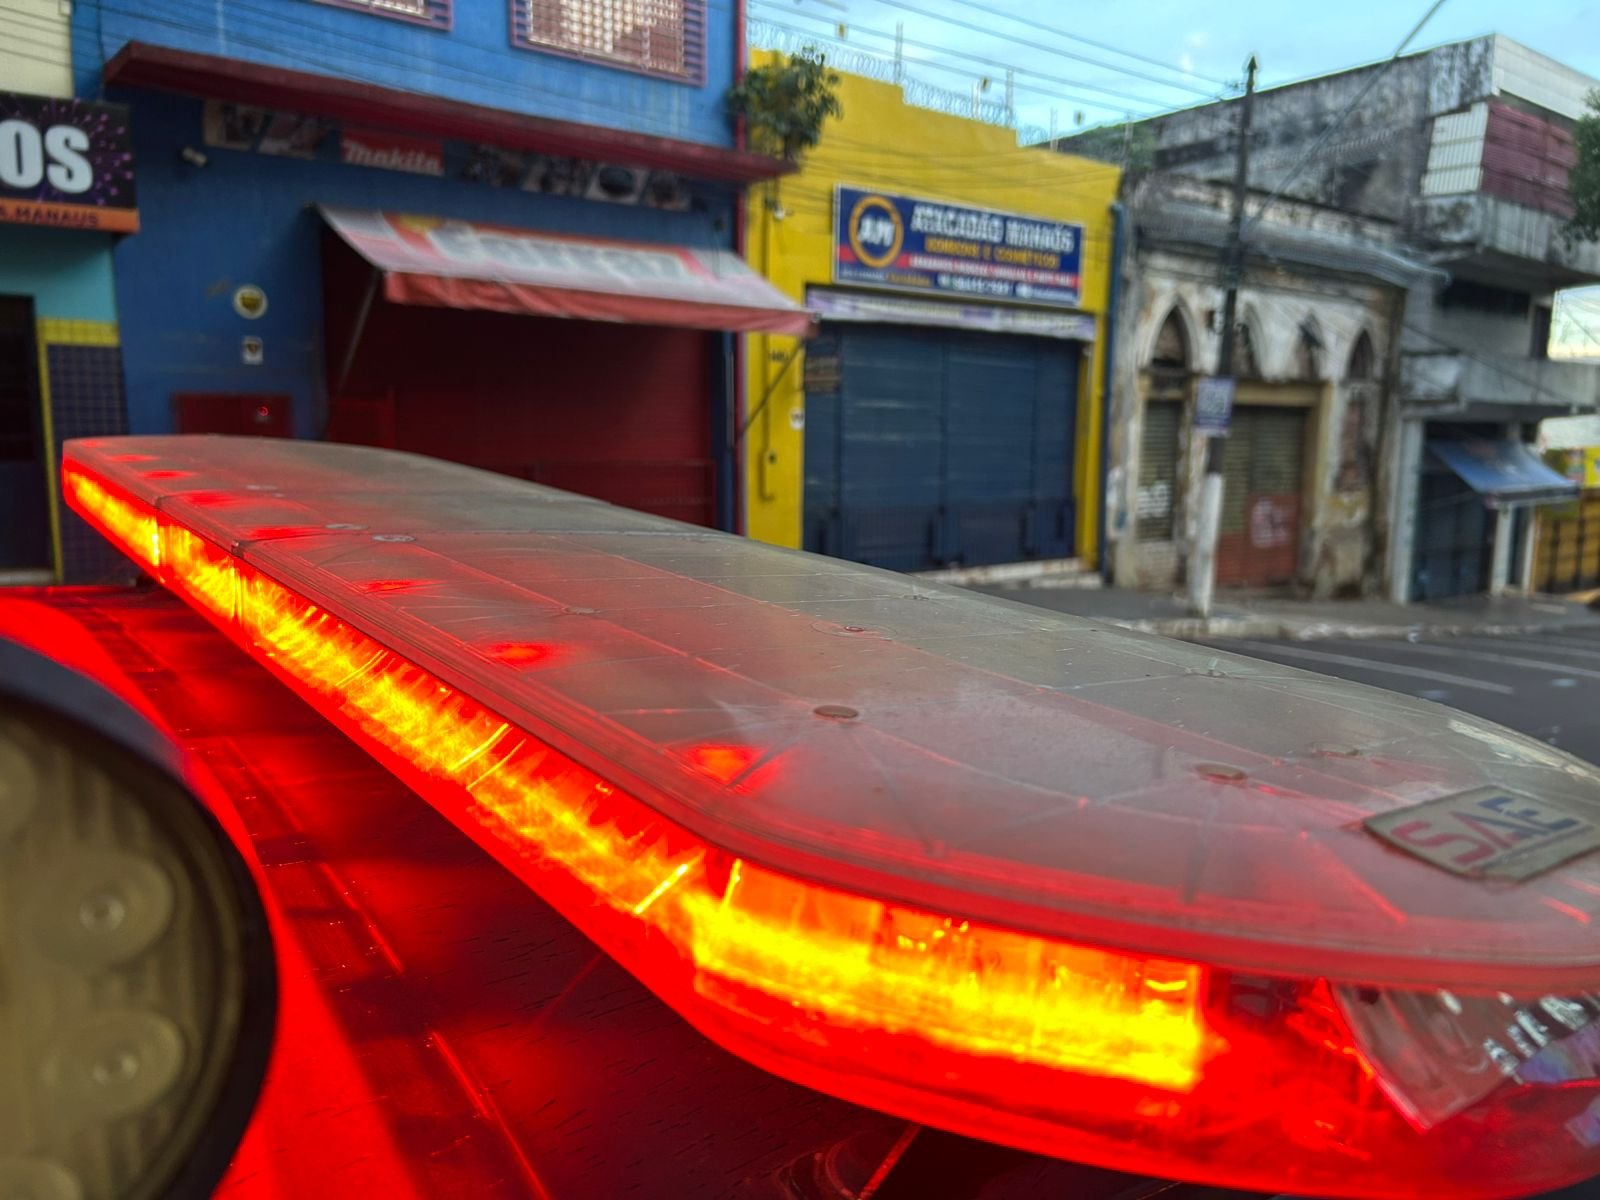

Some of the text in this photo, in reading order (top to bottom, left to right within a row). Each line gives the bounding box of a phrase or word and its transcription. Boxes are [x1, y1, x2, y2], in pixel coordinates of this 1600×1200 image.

[0, 119, 93, 194] OS
[16, 206, 97, 229] MANAUS
[1389, 796, 1580, 866] SAE
